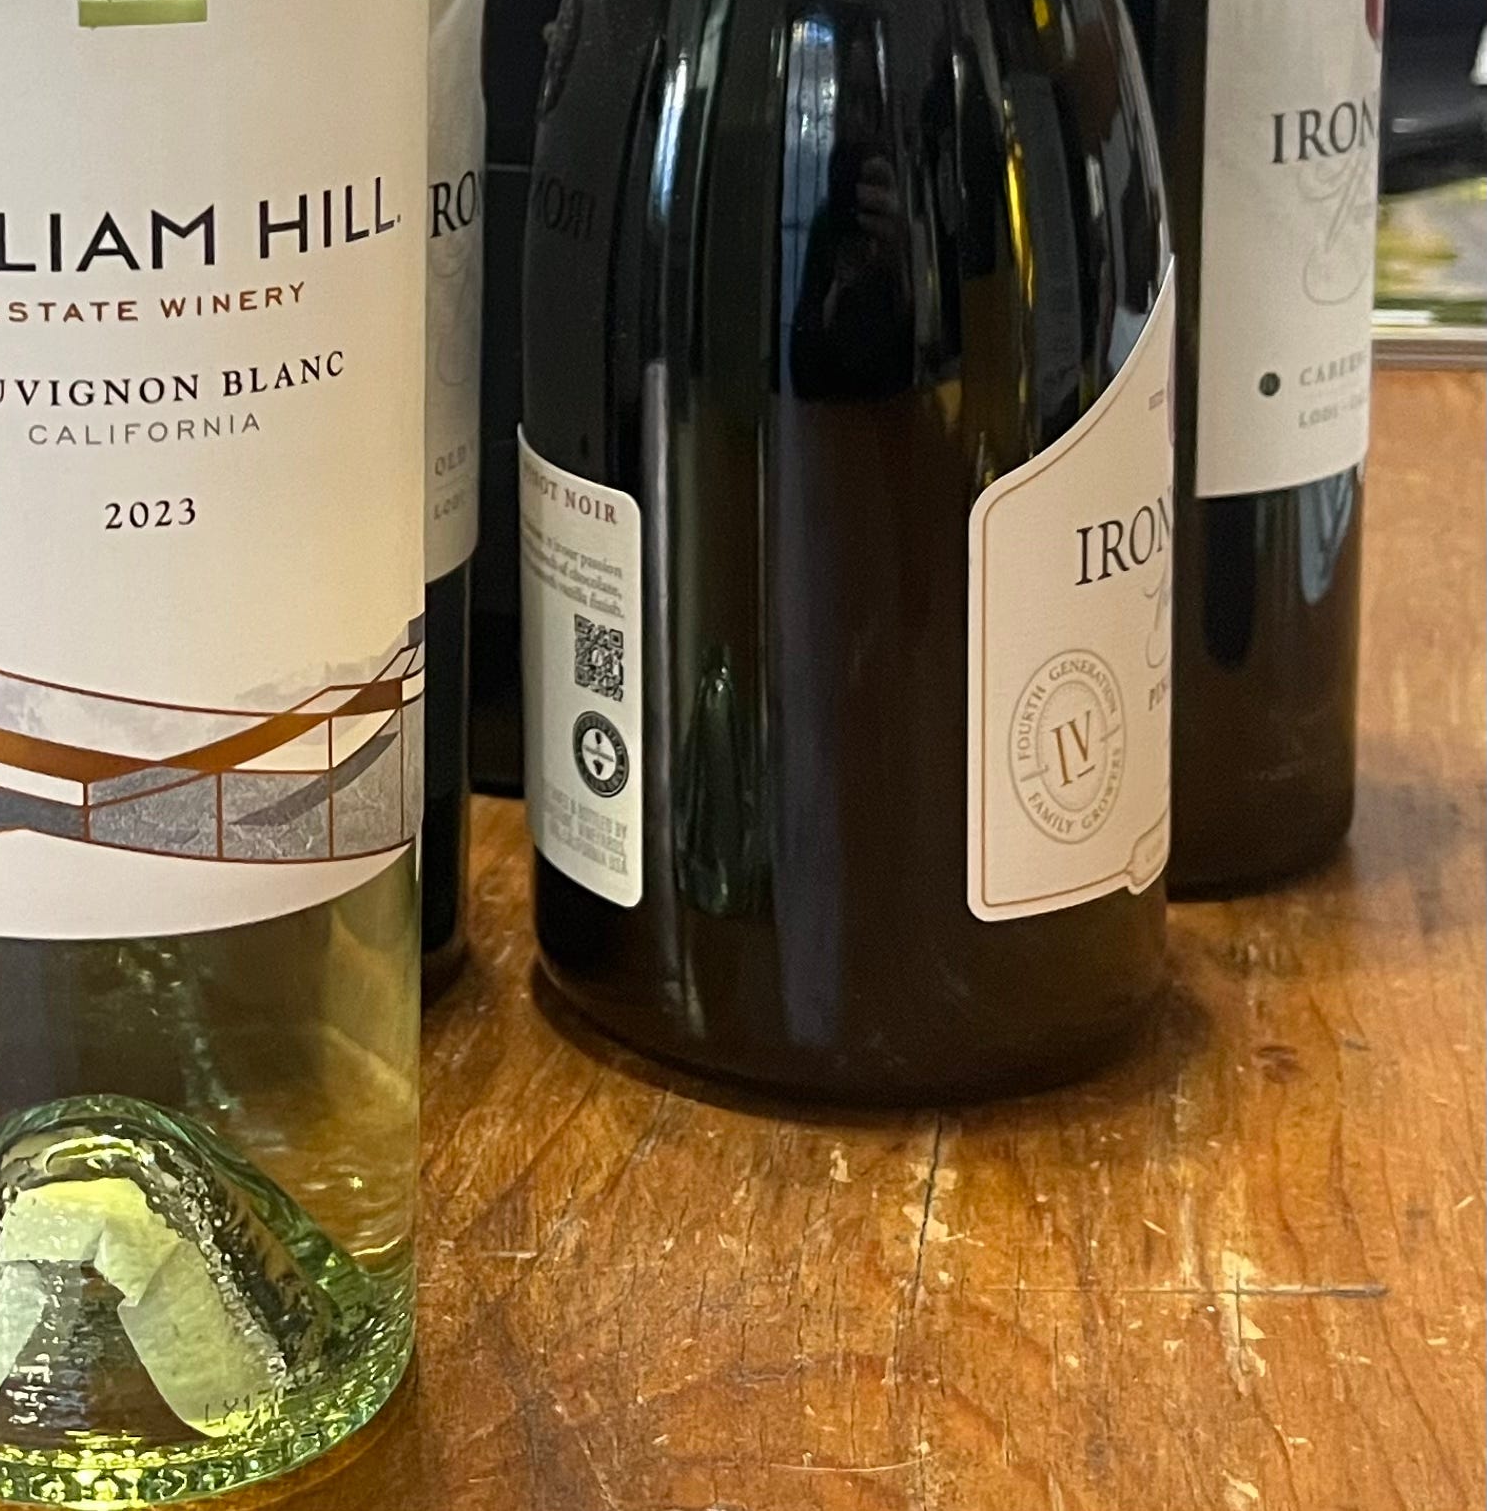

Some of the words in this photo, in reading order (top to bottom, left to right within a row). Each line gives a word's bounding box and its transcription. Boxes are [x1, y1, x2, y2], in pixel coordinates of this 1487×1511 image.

[259, 177, 396, 260] HILL
[160, 281, 306, 320] WINERY
[221, 350, 345, 397] BLANC
[28, 412, 262, 446] CALIFORNIA
[104, 497, 198, 531] 2023
[564, 488, 618, 525] NOIR
[1017, 684, 1047, 762] FOURTH
[1050, 709, 1093, 788] IV
[1027, 791, 1075, 834] FAMILY
